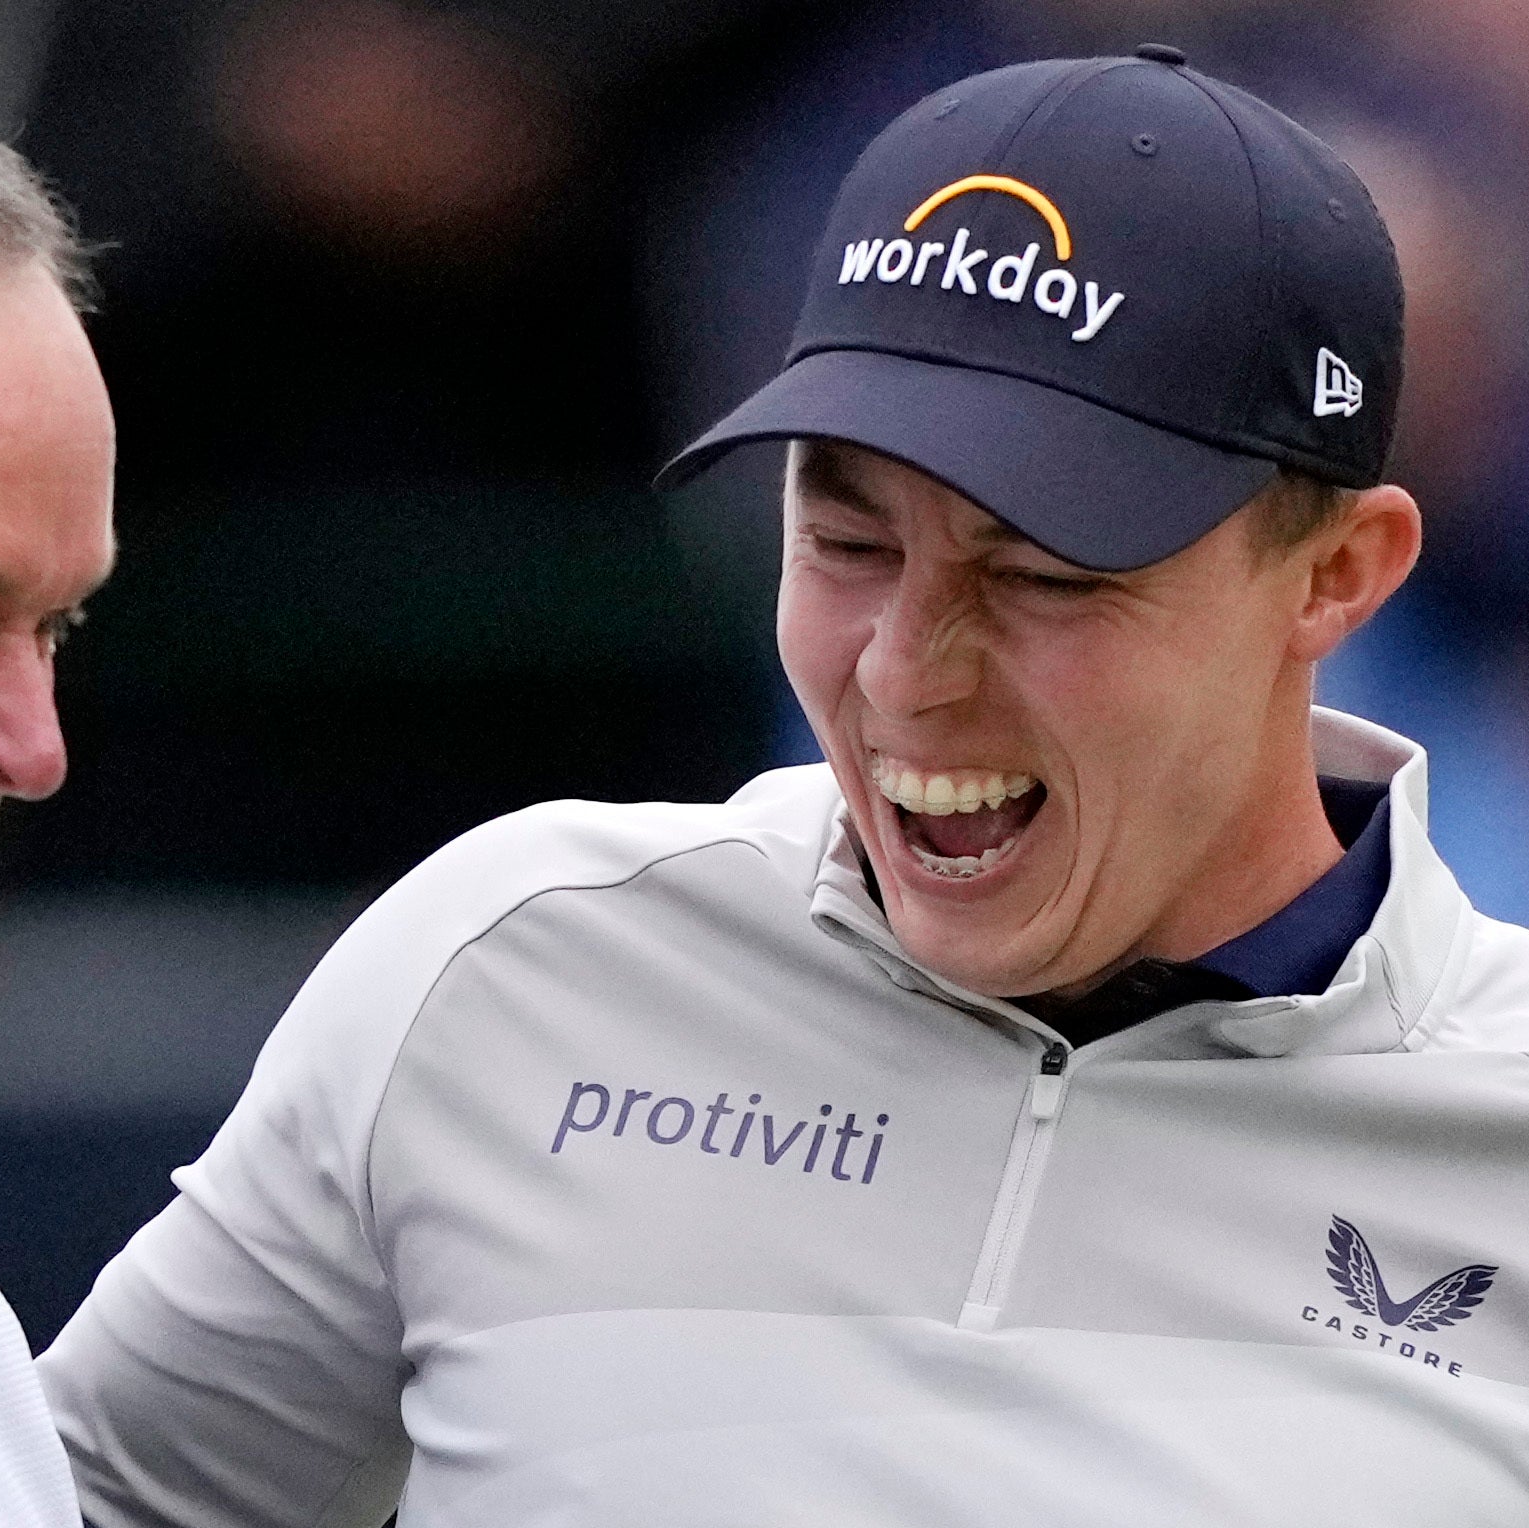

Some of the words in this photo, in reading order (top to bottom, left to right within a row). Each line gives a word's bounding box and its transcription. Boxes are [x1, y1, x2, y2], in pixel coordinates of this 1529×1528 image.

[837, 228, 1126, 342] workday
[550, 1082, 890, 1185] protiviti
[1301, 1305, 1463, 1378] CASTORE
